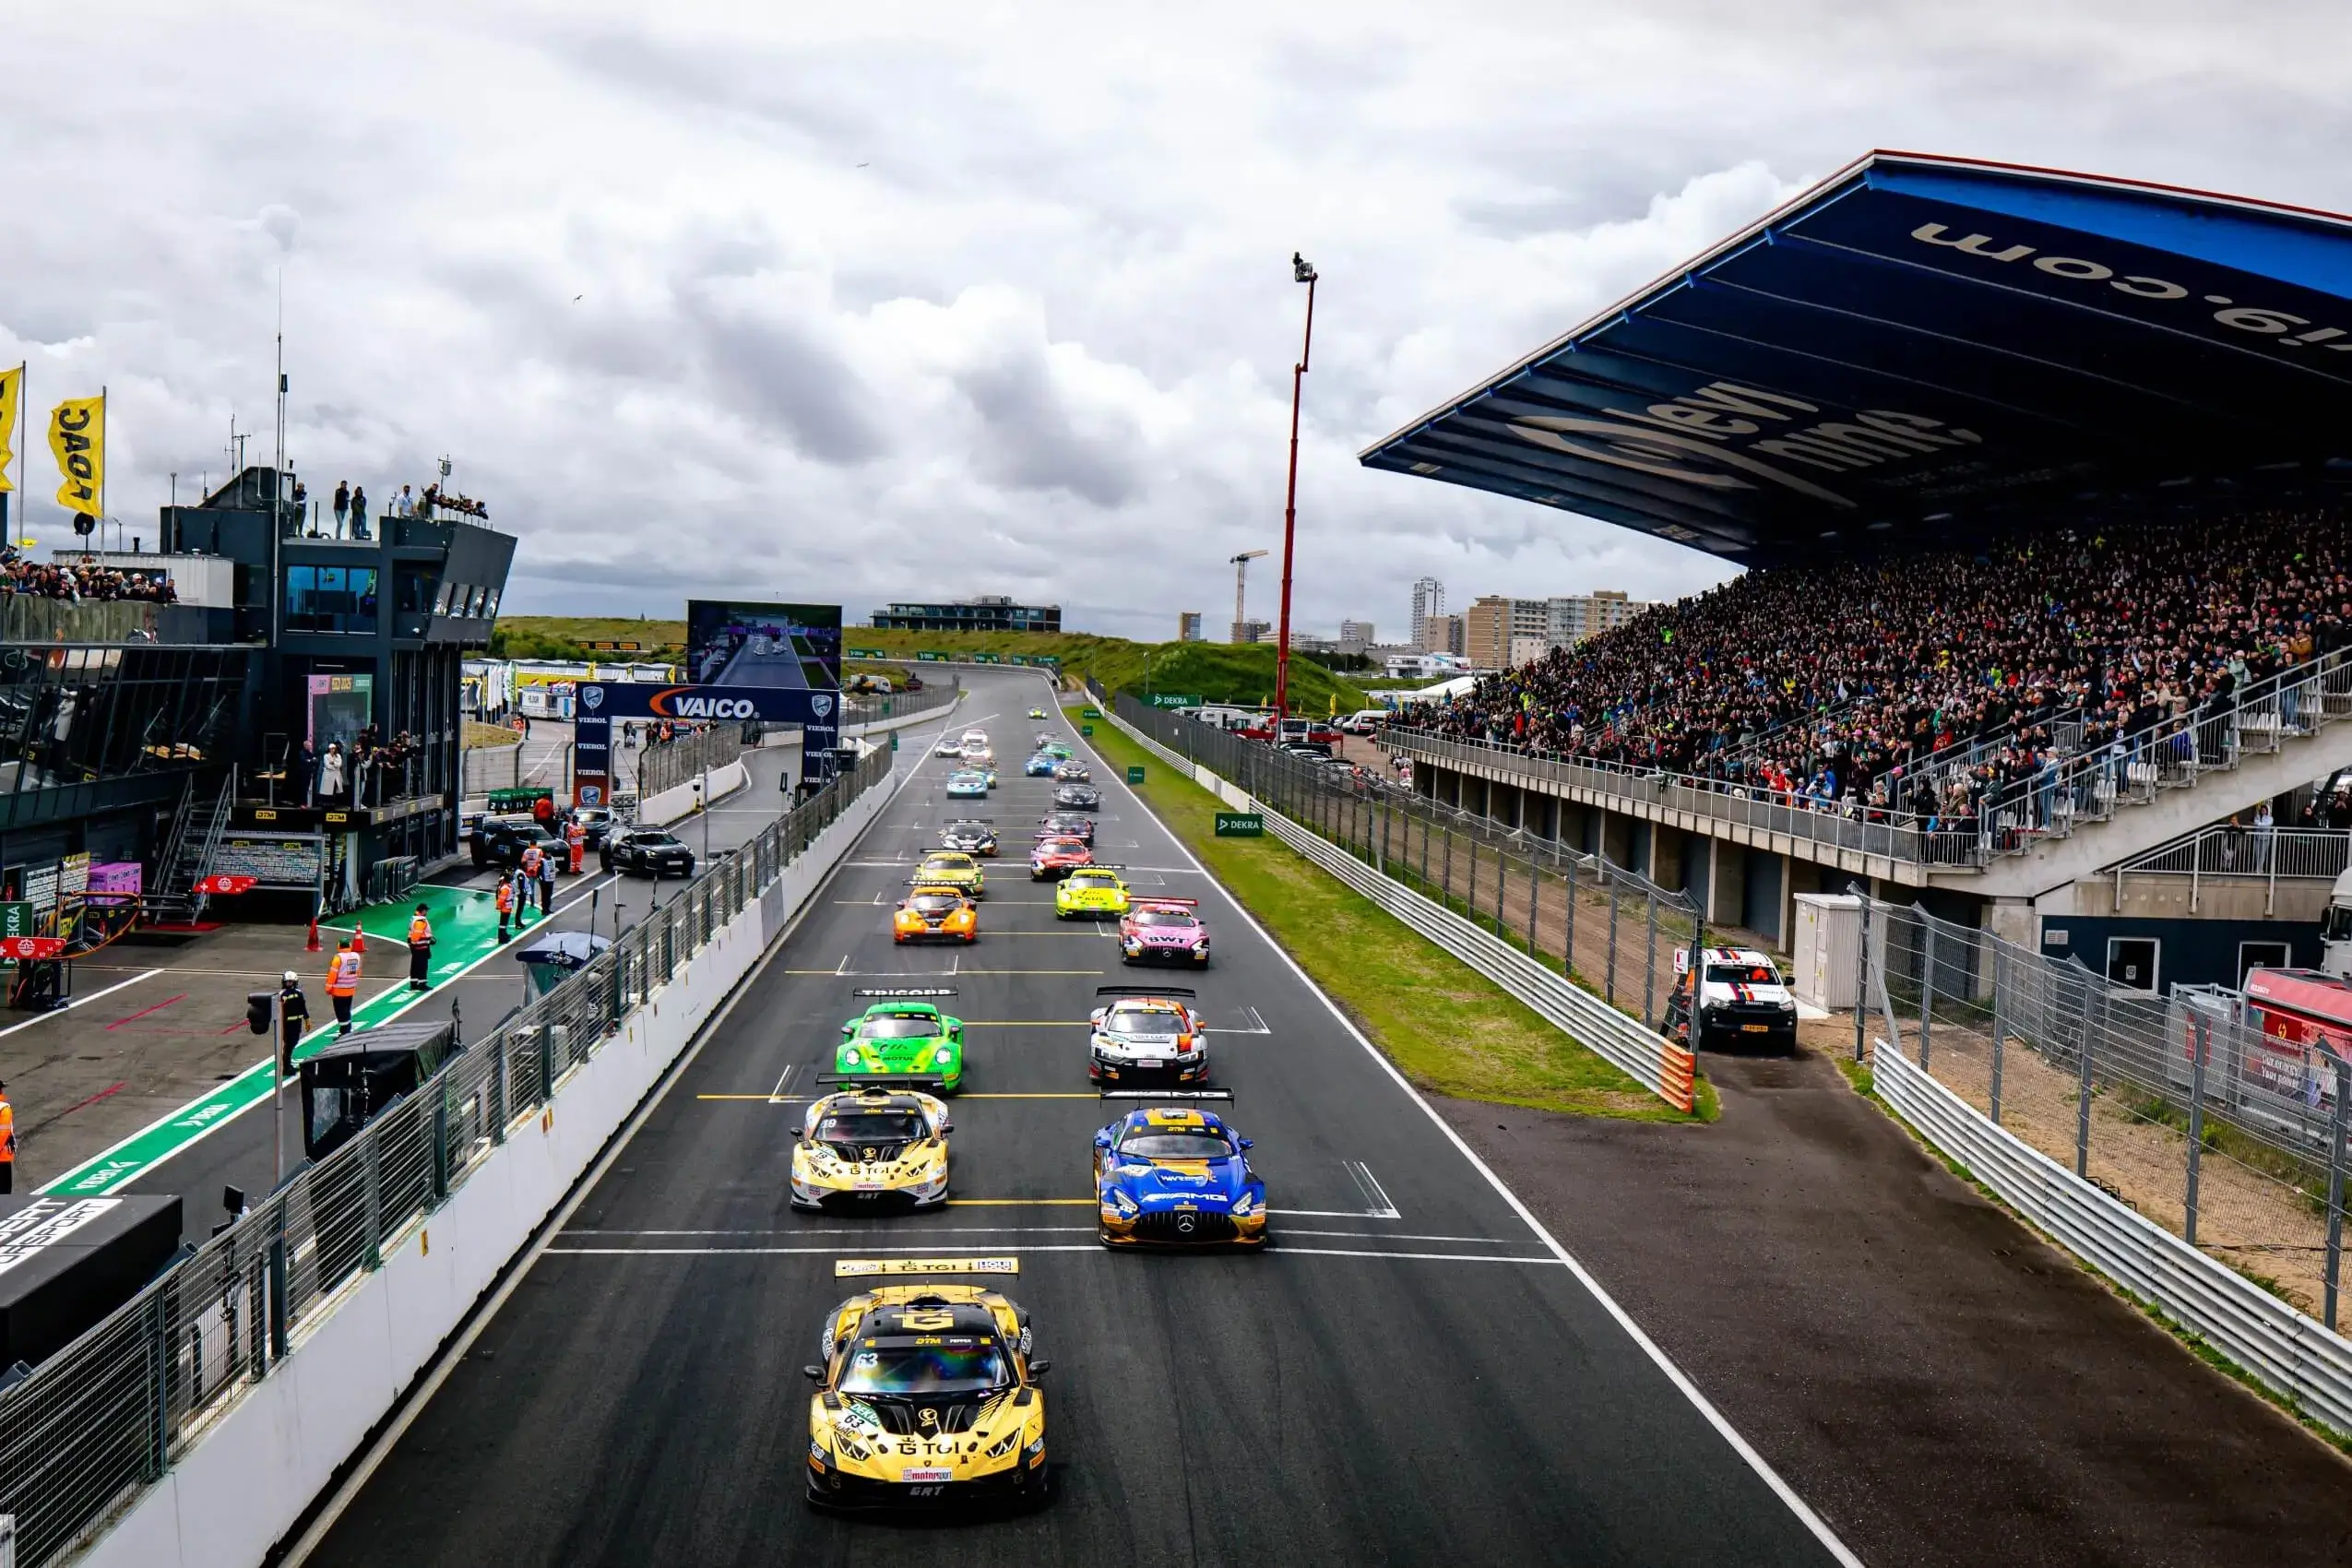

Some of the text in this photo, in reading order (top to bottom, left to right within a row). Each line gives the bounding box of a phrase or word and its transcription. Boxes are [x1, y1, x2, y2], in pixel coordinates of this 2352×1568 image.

[58, 408, 93, 501] ADAC
[1164, 696, 1188, 705] DEKRA
[675, 698, 754, 719] VAICO
[1230, 820, 1259, 829] DEKRA
[7, 906, 20, 938] EKRA
[1173, 1192, 1229, 1202] AMG
[856, 1352, 878, 1368] 63
[844, 1414, 865, 1429] 63
[922, 1442, 959, 1455] TGI
[912, 1470, 952, 1480] motorsport
[909, 1486, 944, 1496] GRT
